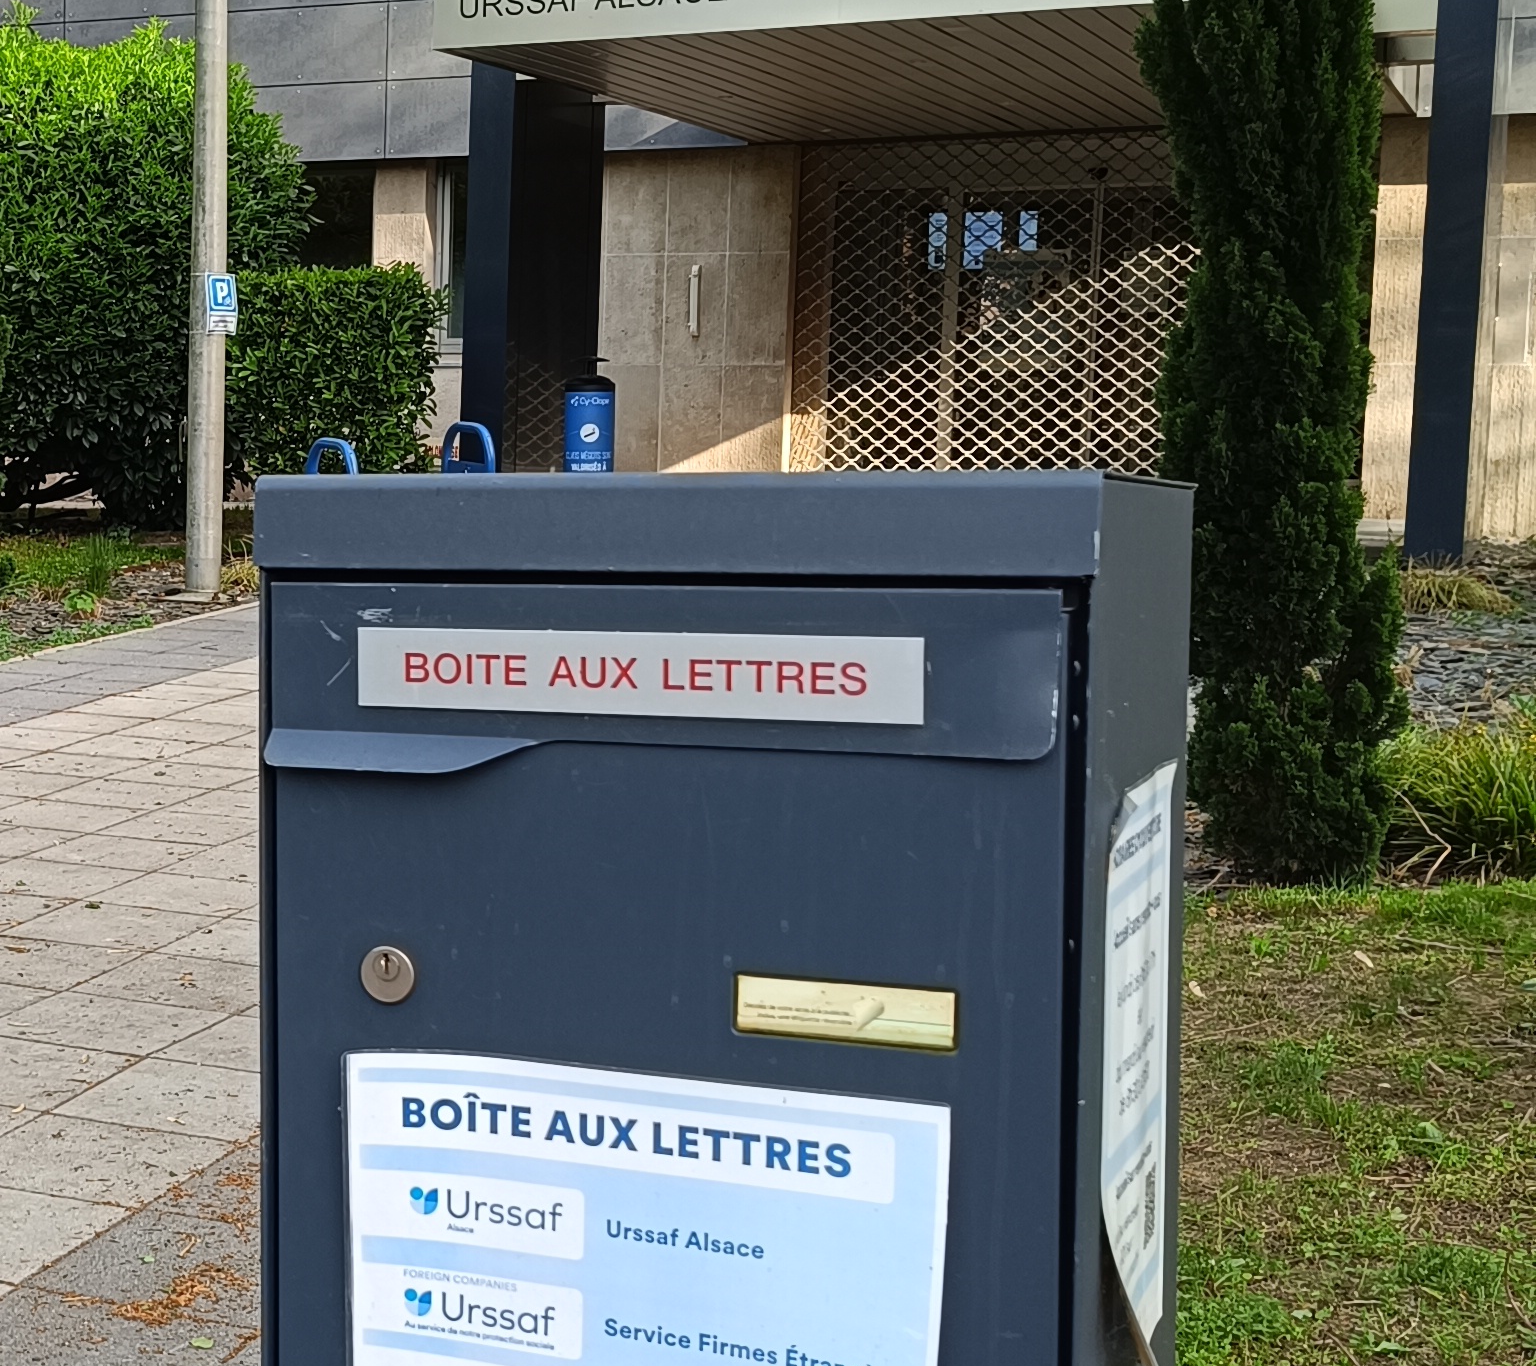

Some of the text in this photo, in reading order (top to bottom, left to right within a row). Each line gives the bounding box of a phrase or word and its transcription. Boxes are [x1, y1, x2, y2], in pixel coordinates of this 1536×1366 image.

[215, 281, 229, 304] P
[405, 653, 866, 696] BOITE AUX LETTRES
[402, 1092, 851, 1177] BOÎTE AUX LETTRES
[447, 1189, 563, 1233] Urssaf
[607, 1219, 764, 1259] Urssaf Alsace
[403, 1269, 517, 1292] FOREIGN COMPANIES
[405, 1320, 416, 1328] Au
[418, 1324, 445, 1333] service
[459, 1329, 480, 1338] notre
[482, 1332, 524, 1345] protection
[526, 1340, 554, 1350] sociale
[441, 1292, 555, 1338] Urssaf
[605, 1318, 690, 1348] Service
[699, 1333, 777, 1364] Firmes
